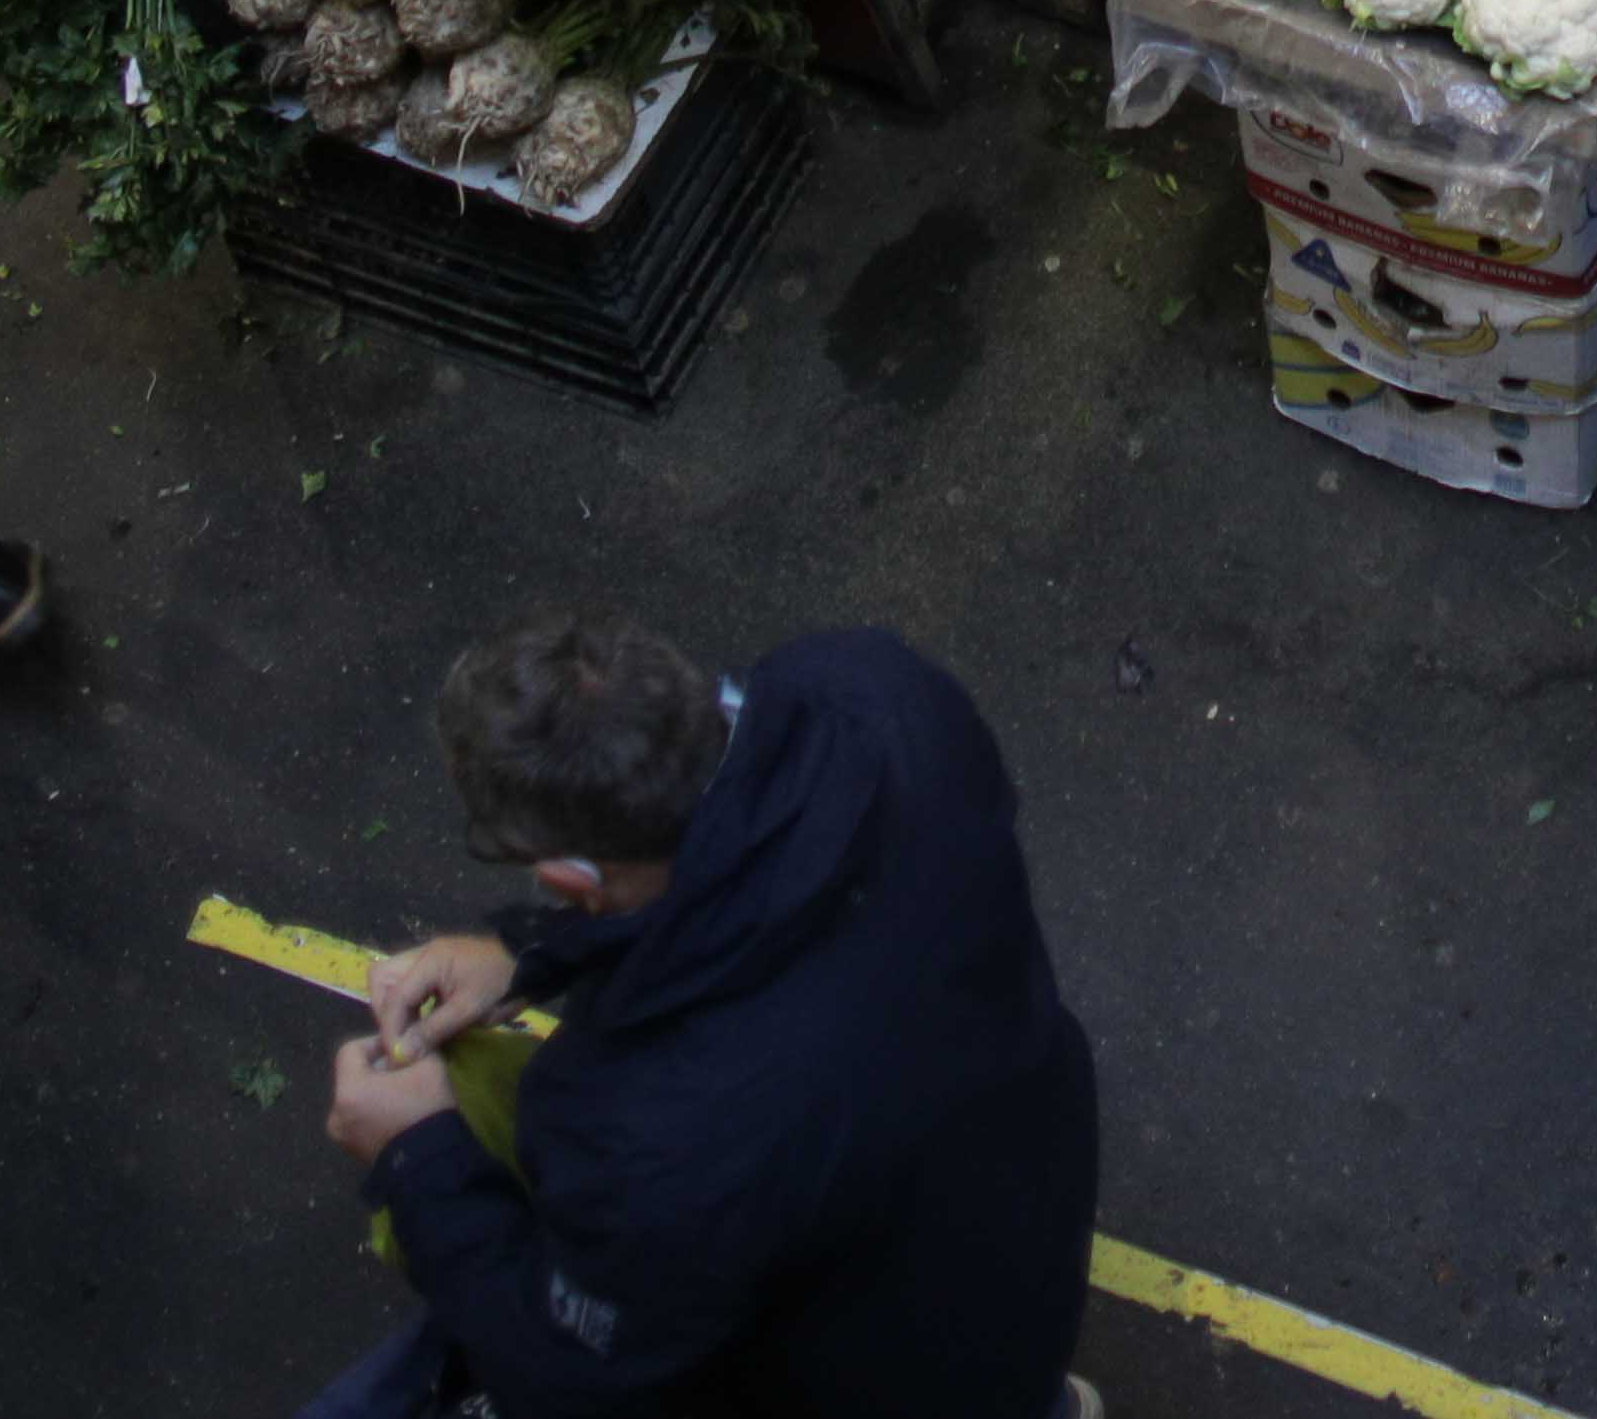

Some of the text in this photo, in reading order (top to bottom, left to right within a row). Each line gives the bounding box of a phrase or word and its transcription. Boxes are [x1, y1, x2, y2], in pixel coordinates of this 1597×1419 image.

[1269, 111, 1335, 150] Dole
[1272, 187, 1335, 220] PREMIUM
[1336, 211, 1401, 248] BANANAS
[1477, 259, 1550, 288] BANANAS
